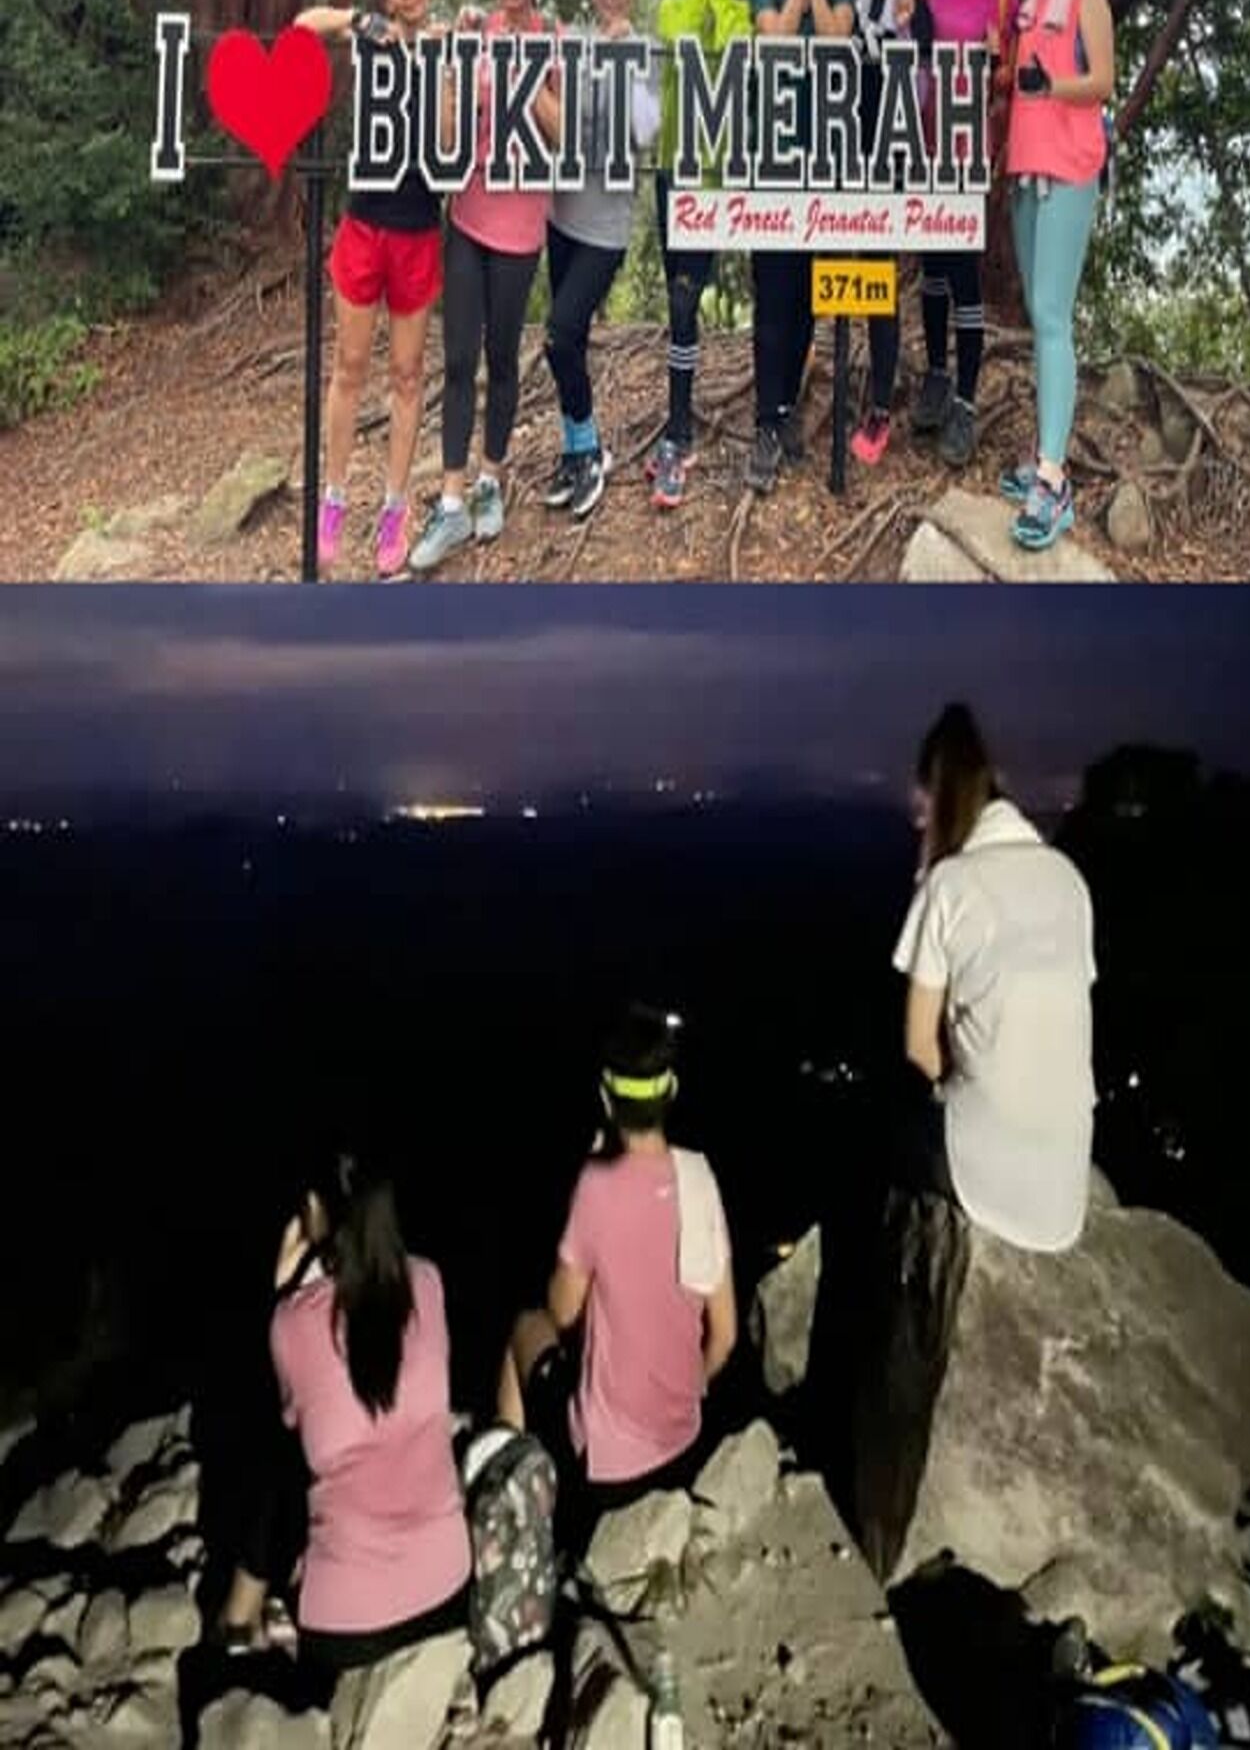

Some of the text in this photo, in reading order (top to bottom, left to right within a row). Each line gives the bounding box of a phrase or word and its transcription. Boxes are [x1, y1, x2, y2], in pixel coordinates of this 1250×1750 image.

[150, 13, 993, 192] I BUKIT MERAH
[674, 194, 717, 233] Red
[904, 197, 979, 242] Pahang
[818, 274, 888, 301] 371m
